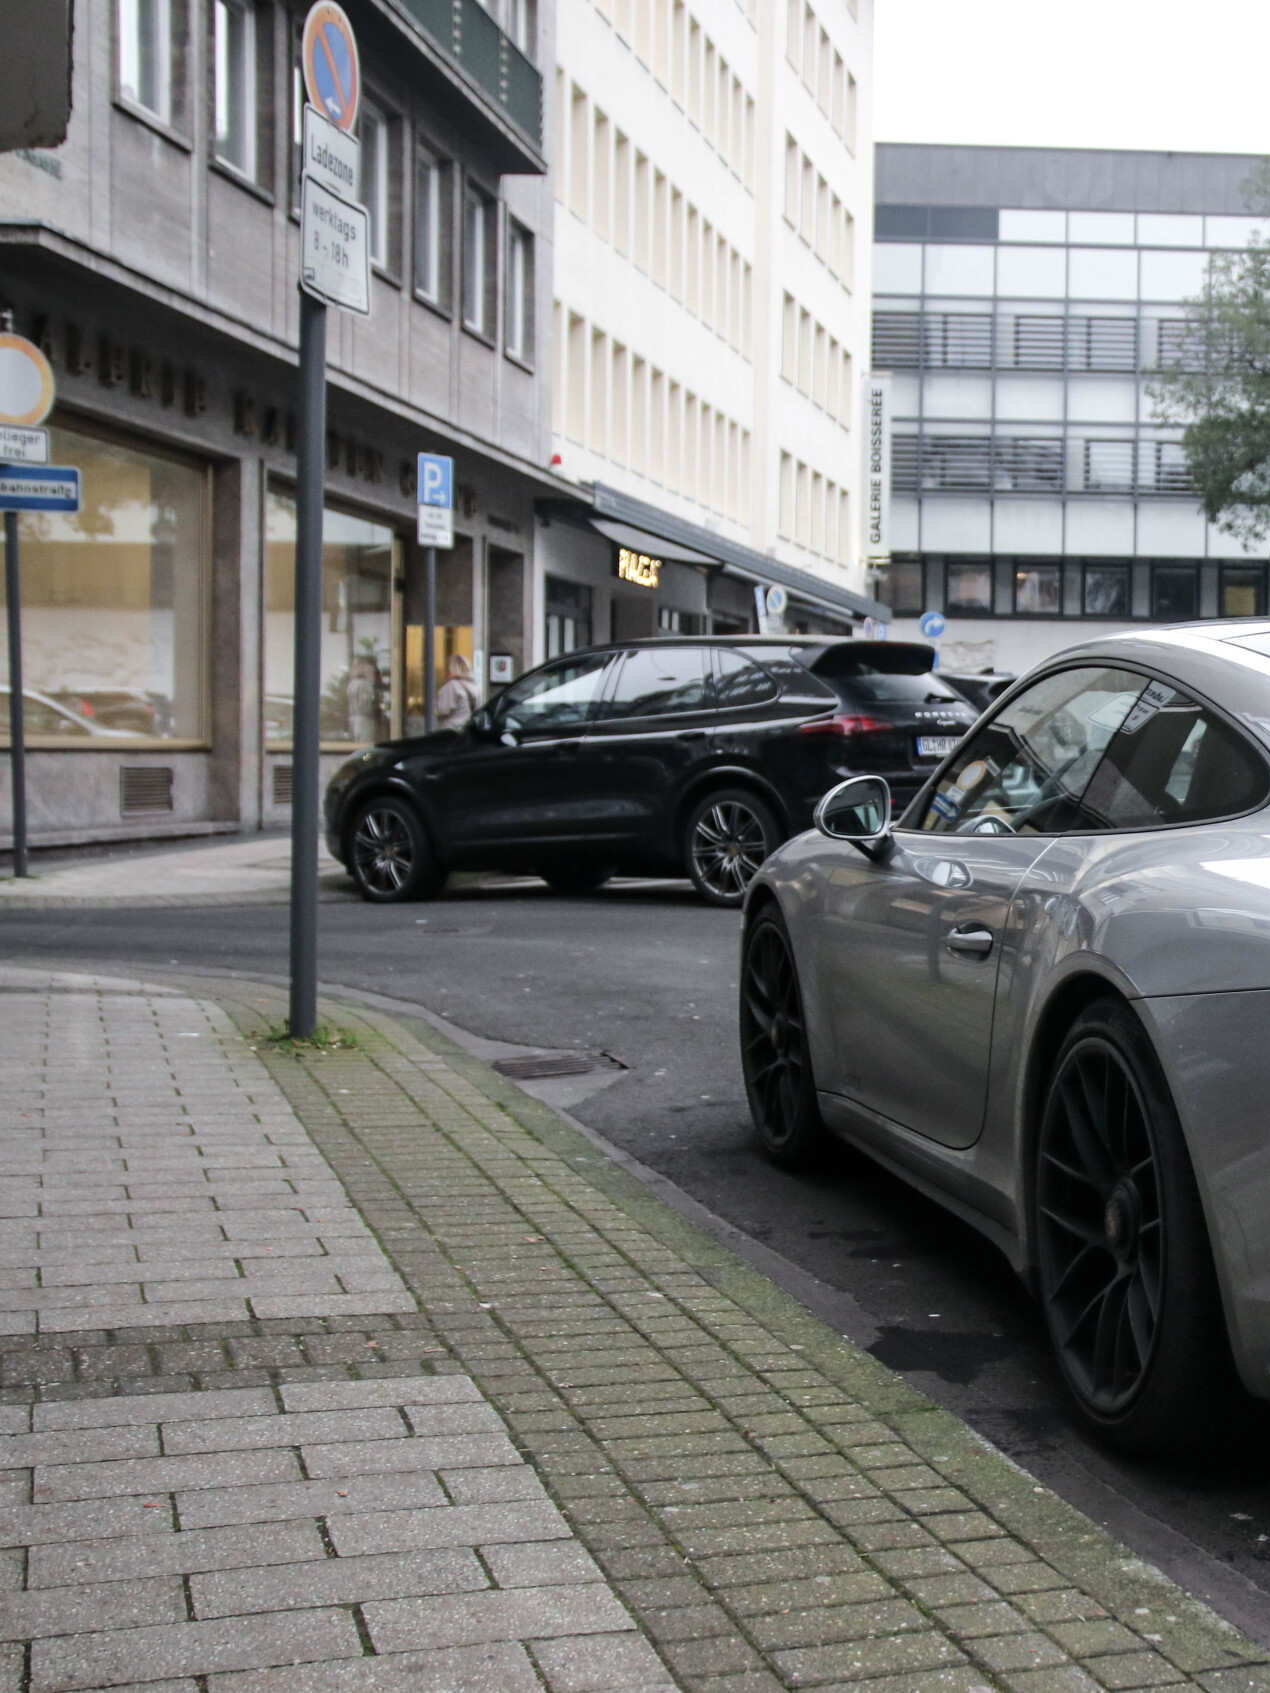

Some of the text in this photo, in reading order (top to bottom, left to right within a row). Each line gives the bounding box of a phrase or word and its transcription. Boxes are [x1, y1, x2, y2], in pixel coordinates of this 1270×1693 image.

[310, 132, 354, 187] Ladezone
[311, 202, 357, 243] werktags
[313, 230, 320, 251] 8
[4, 445, 25, 457] frei
[424, 461, 442, 503] P
[869, 478, 882, 544] GALERIE
